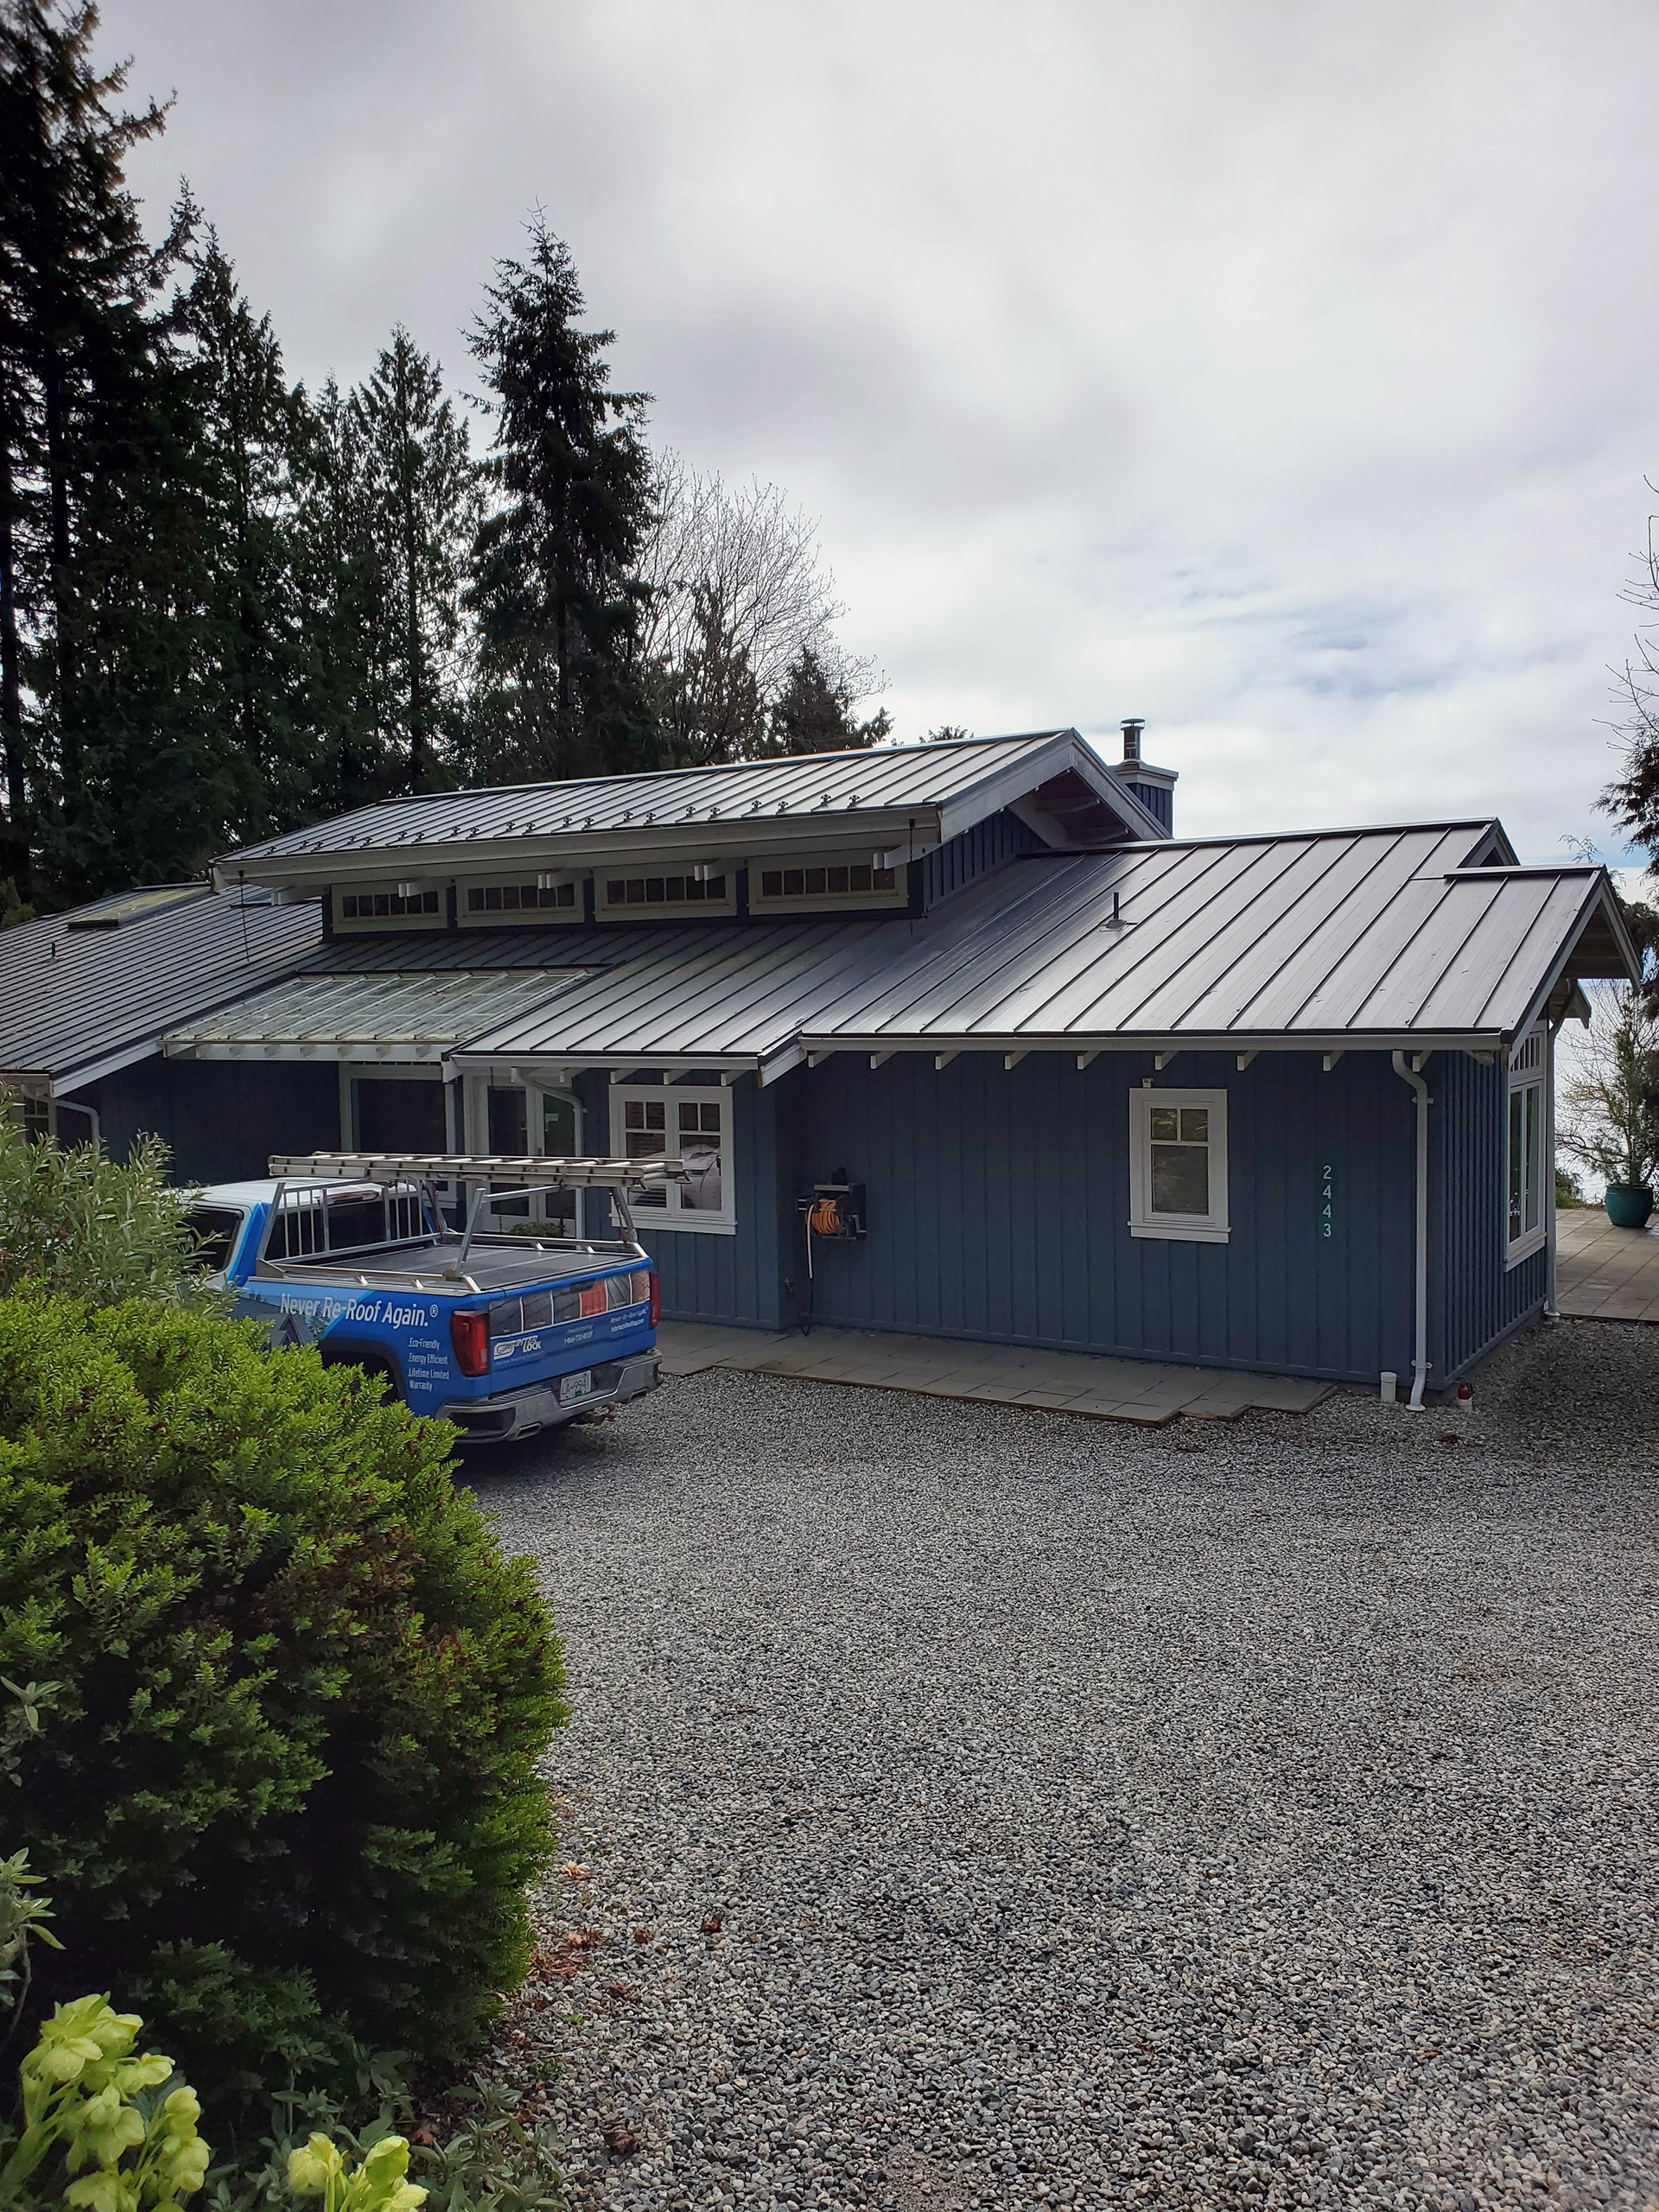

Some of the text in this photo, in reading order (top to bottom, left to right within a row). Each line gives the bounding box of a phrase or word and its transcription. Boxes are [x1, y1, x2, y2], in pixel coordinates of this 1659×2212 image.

[1322, 1165, 1332, 1237] 2443
[280, 1294, 320, 1317] Never
[322, 1297, 382, 1322] Re-Roof
[516, 1335, 538, 1347] INTER
[523, 1340, 542, 1353] LOCK
[427, 1353, 448, 1364] Efficient
[430, 1369, 449, 1380] Limited
[409, 1380, 433, 1392] Warranty
